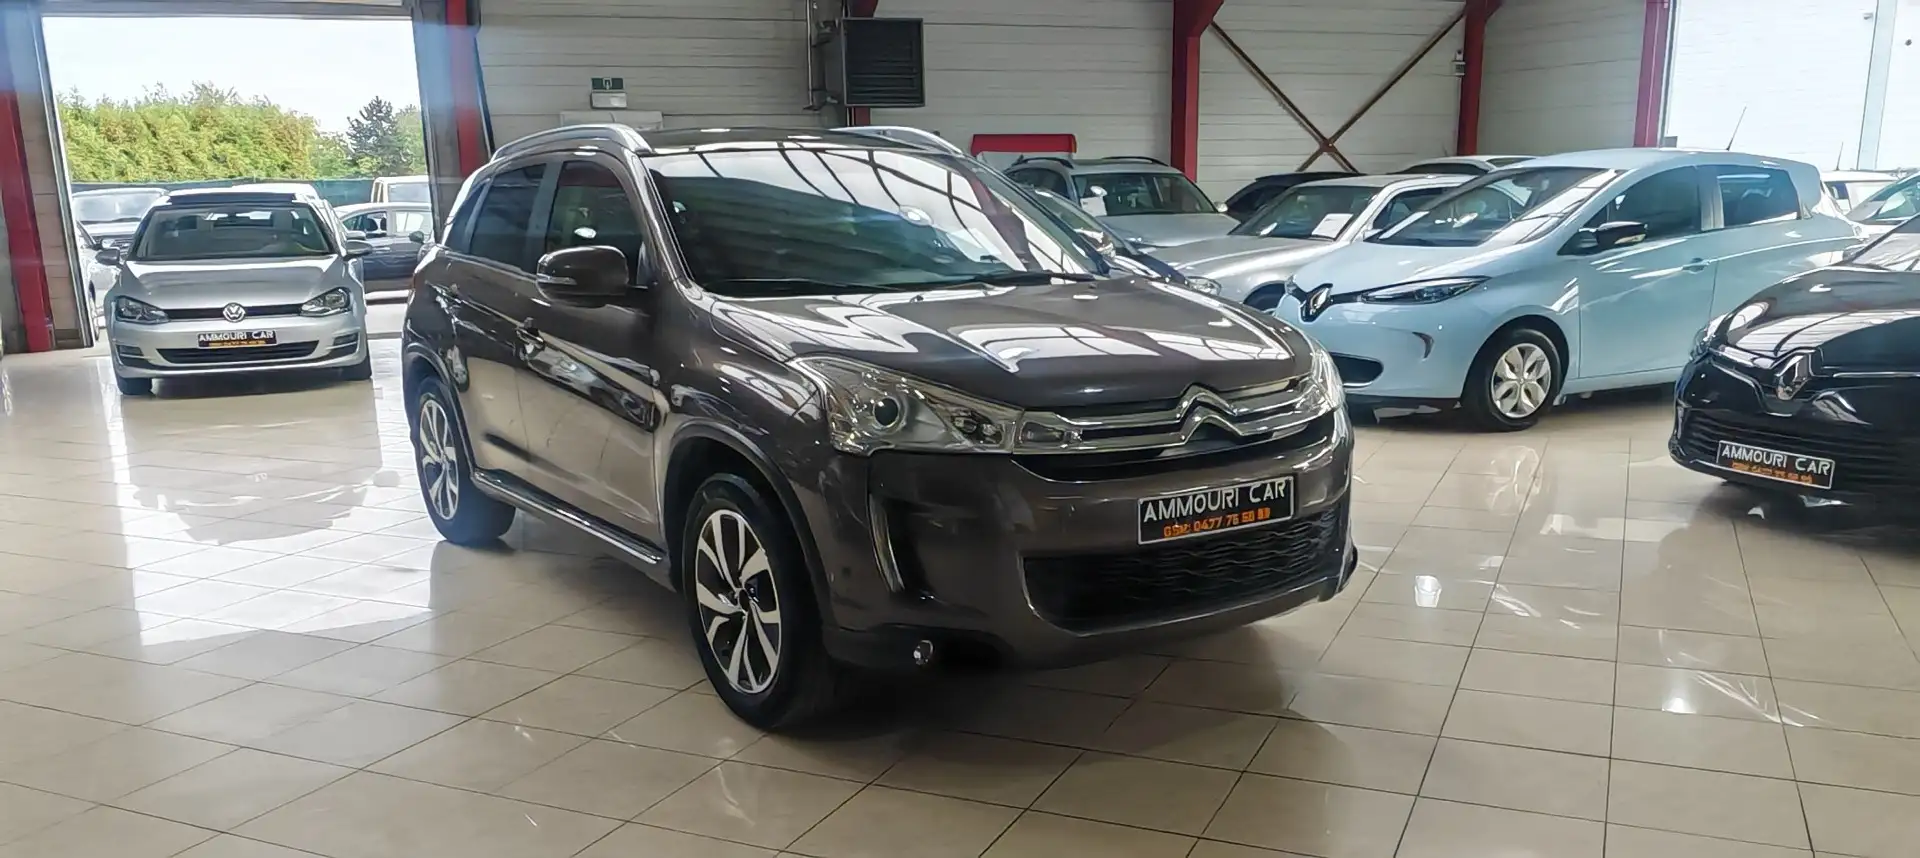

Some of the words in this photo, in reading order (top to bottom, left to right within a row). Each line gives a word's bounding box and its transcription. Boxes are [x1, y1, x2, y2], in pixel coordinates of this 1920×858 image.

[199, 332, 248, 341] AMMOURI
[252, 330, 274, 339] CAR
[1722, 445, 1788, 468] AMMOURI
[1795, 458, 1831, 475] CAR
[1144, 488, 1239, 522] AMMOURI
[1250, 480, 1286, 503] CAR
